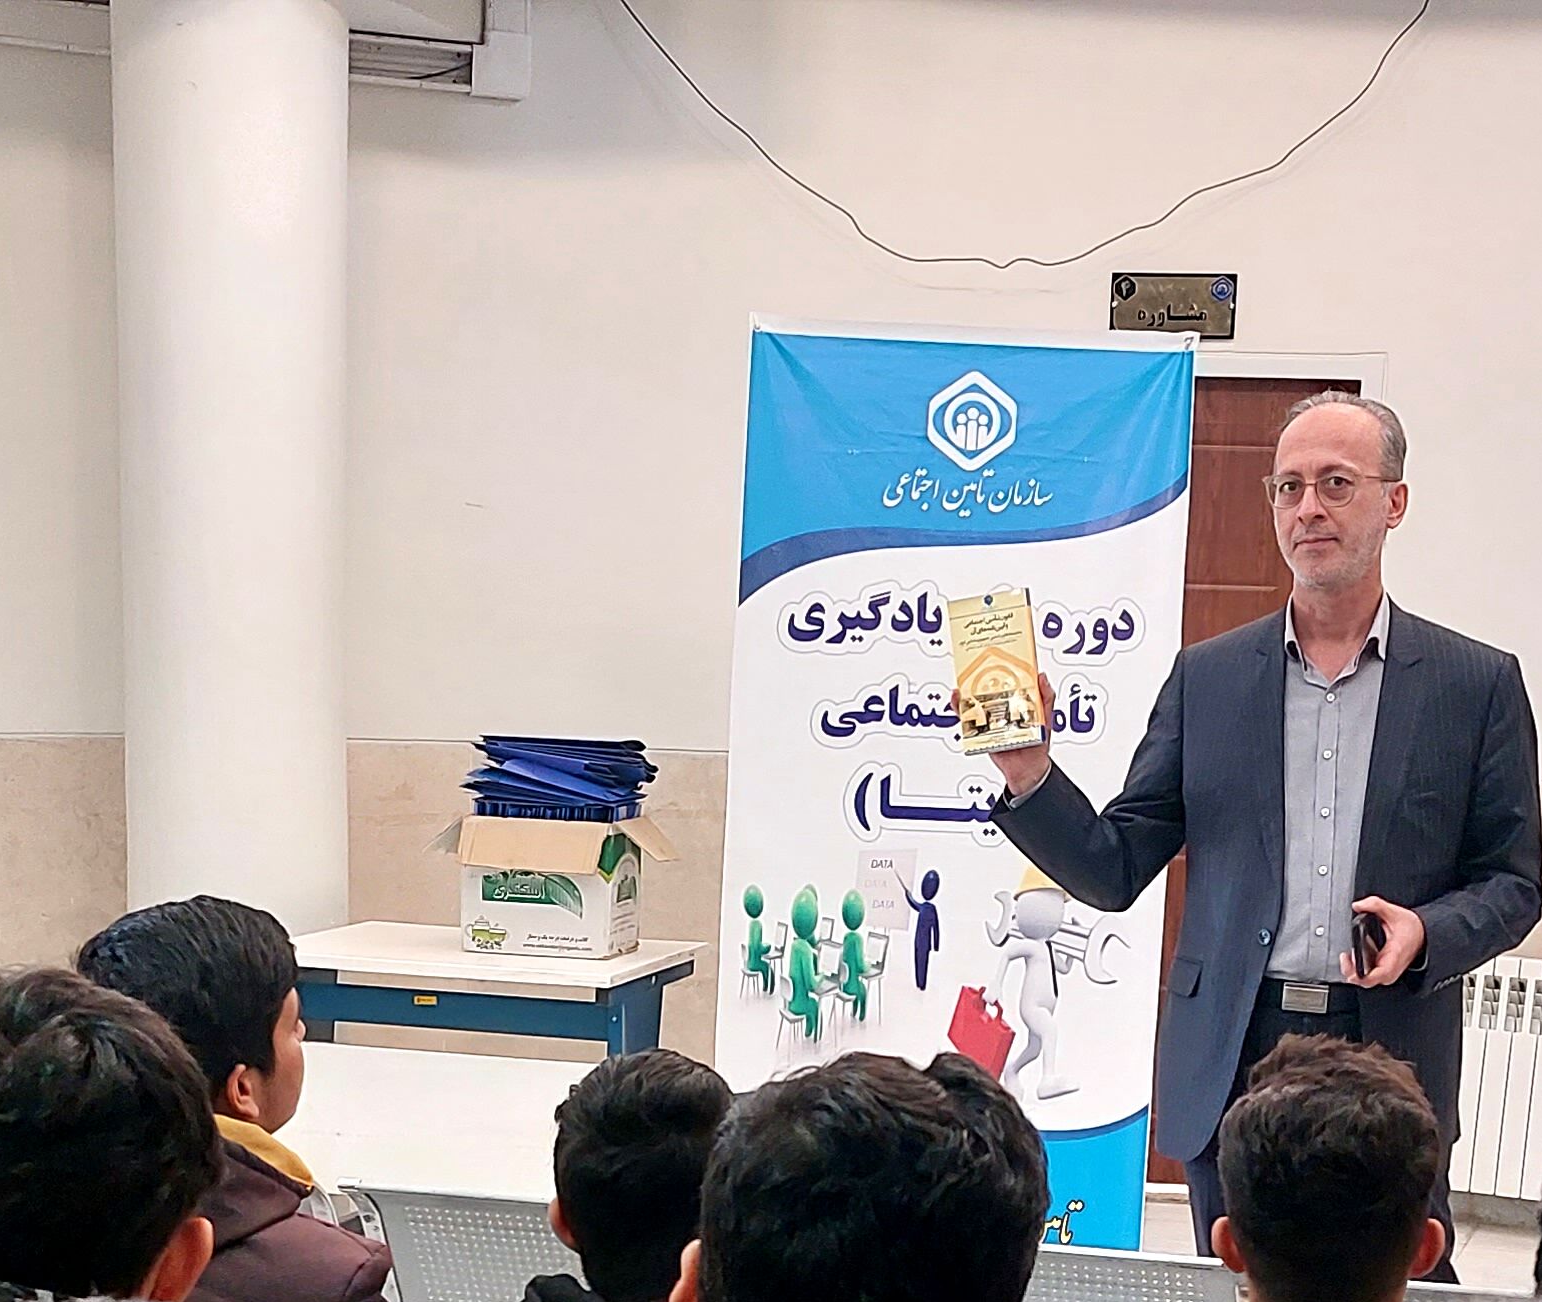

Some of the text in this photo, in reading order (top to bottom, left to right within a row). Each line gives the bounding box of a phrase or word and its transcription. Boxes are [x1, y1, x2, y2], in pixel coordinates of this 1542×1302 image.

[1137, 303, 1207, 327] مشاوره
[881, 467, 941, 511] اجتماعی
[987, 478, 1054, 514] سازمان
[787, 591, 1136, 655] دوره یادگیری
[820, 683, 1098, 742] تأم جتماعی
[870, 859, 894, 869] DATA
